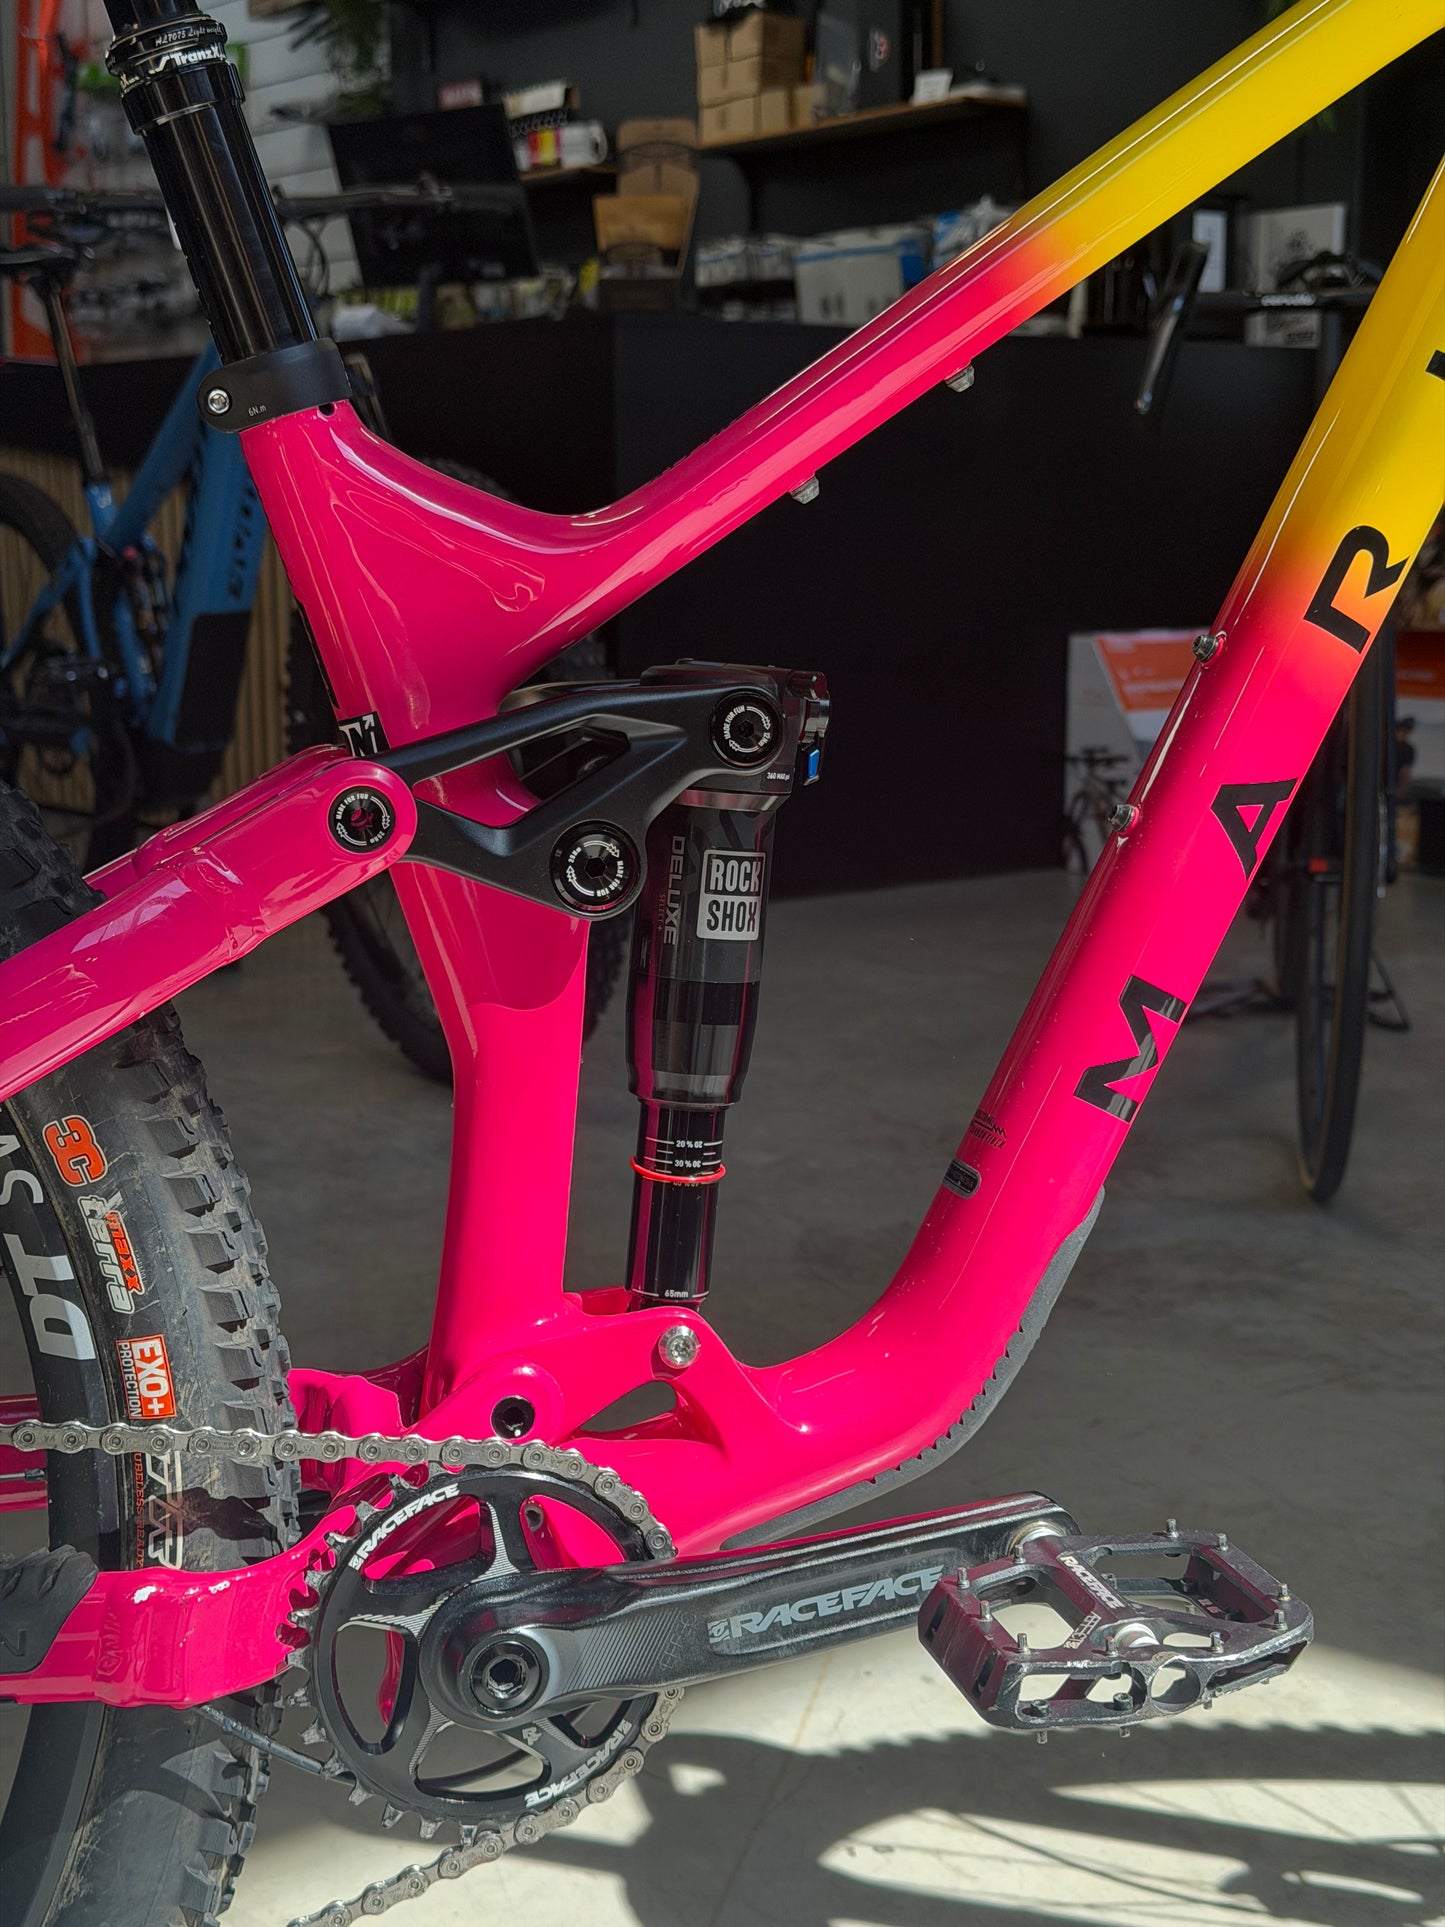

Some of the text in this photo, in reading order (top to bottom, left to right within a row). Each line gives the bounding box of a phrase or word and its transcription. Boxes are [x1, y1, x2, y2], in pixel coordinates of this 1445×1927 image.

[170, 42, 220, 66] TranzX
[1074, 350, 1445, 1123] MAR
[663, 835, 686, 945] DELUXE
[709, 858, 762, 893] ROCK
[706, 899, 758, 933] SHOX
[43, 1116, 107, 1186] 3C
[674, 1159, 684, 1167] 30
[676, 1140, 685, 1148] 20
[3, 1232, 96, 1360] DT
[664, 1289, 689, 1299] 65mm
[118, 1341, 142, 1417] PROTECTION
[131, 1338, 169, 1415] EXO+
[133, 1453, 146, 1568] UBELESS READY
[357, 1483, 461, 1560] RACEFACE
[729, 1564, 945, 1639] RACEFACE
[1060, 1555, 1126, 1610] RACEFACE
[524, 1730, 626, 1809] RACEFACE
